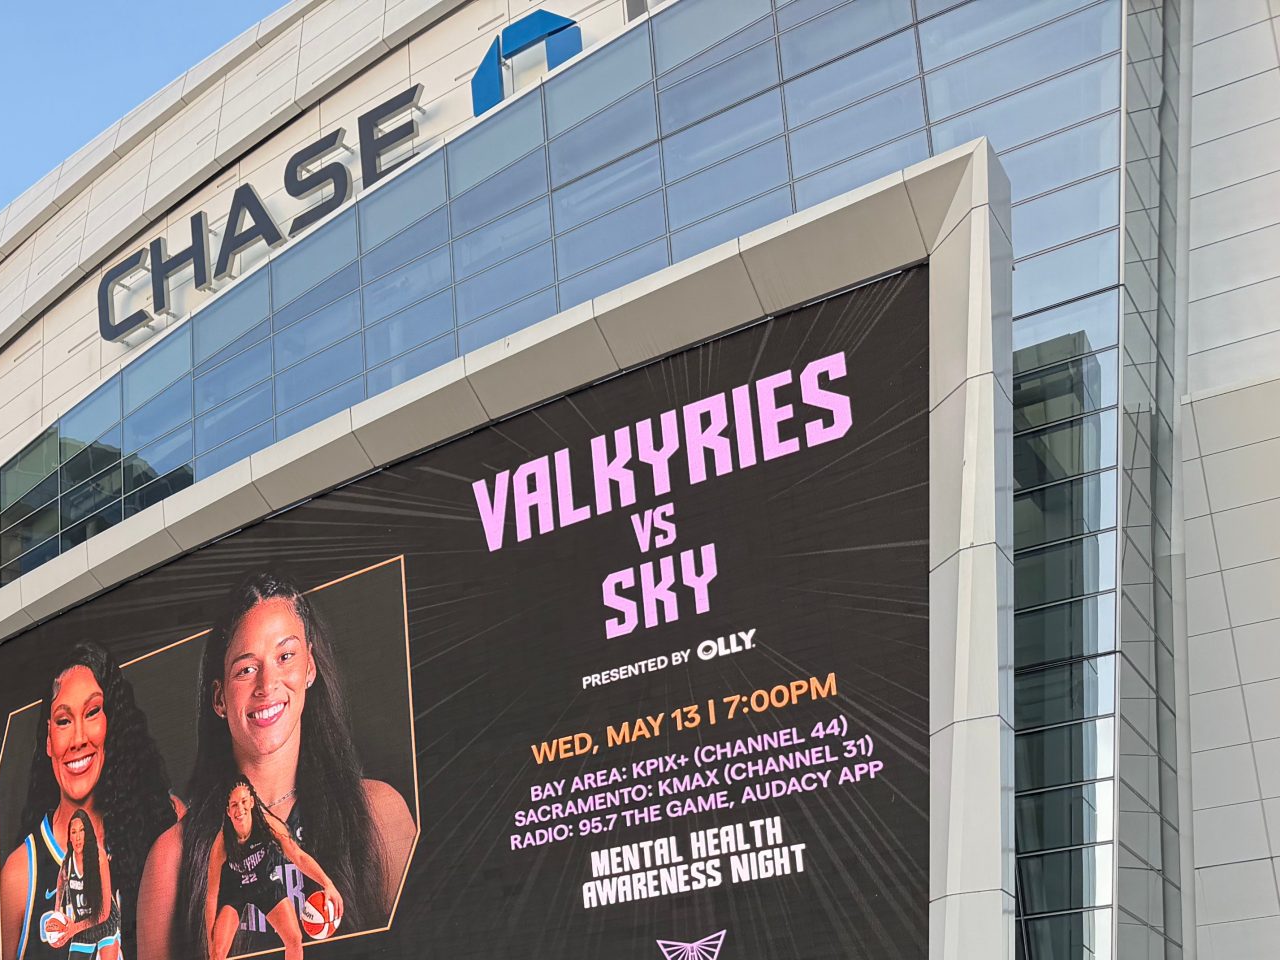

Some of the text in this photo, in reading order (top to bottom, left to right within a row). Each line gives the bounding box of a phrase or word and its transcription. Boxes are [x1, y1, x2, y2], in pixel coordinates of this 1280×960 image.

[97, 82, 424, 343] CHASE
[472, 351, 853, 553] VALKYRIES
[631, 502, 677, 553] VS
[602, 543, 718, 640] SKY
[582, 656, 669, 690] PRESENTED
[671, 649, 691, 667] BY
[530, 714, 848, 802] BAY AREA: KPIX+ (CHANNEL 44)
[531, 732, 600, 766] WED,
[606, 713, 665, 749] MAY
[671, 704, 702, 733] 13
[722, 672, 838, 721] 7:00PM
[509, 760, 885, 851] RADIO: 95.7 THE GAME, AUDACY APP
[514, 734, 875, 827] SACRAMENTO: KMAX (CHANNEL 31)
[582, 843, 806, 909] AWARENESS NIGHT
[590, 815, 783, 878] MENTAL HEALTH
